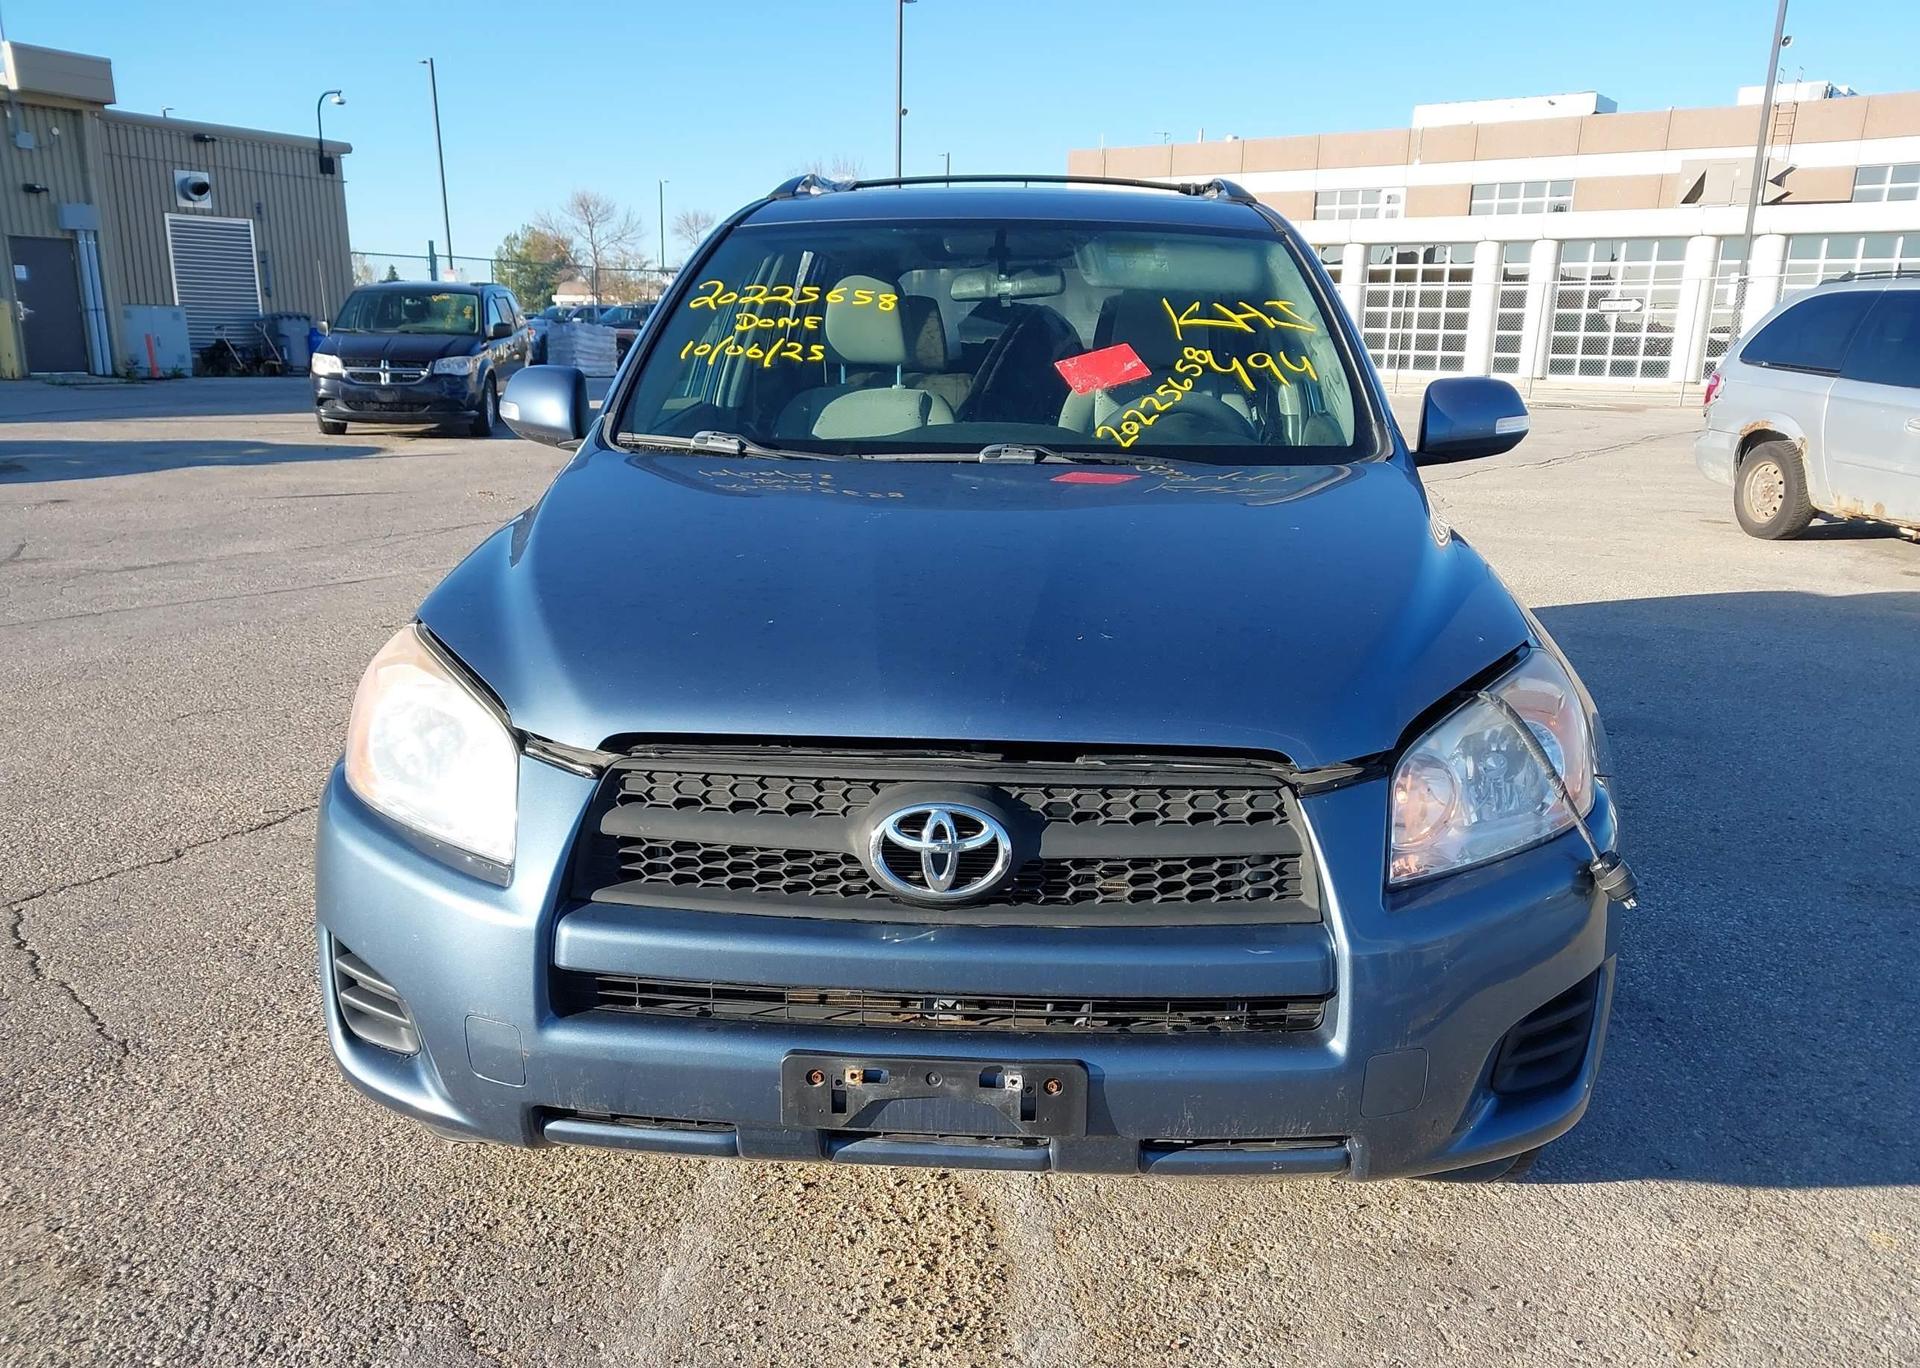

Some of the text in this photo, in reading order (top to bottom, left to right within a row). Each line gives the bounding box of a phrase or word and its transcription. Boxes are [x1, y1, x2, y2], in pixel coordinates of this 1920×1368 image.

[689, 280, 898, 310] 20225658
[680, 336, 825, 367] 10/06/25
[1208, 350, 1317, 391] 494
[1096, 347, 1209, 447] 20225658
